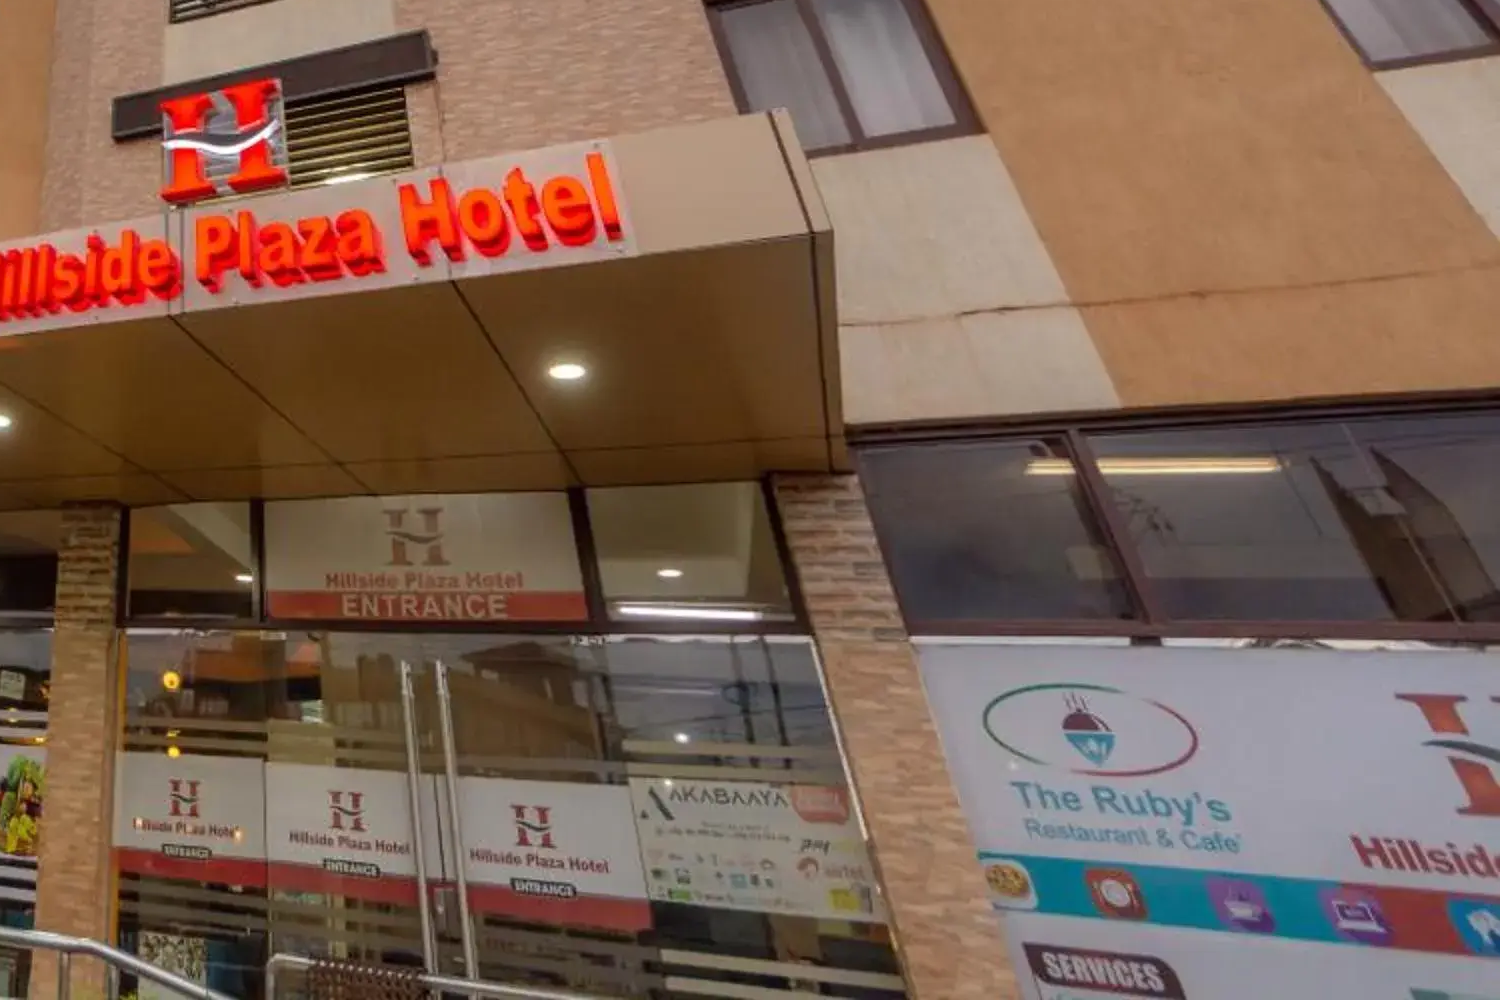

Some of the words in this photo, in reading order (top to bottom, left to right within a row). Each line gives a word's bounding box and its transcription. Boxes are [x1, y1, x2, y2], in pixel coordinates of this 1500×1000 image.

[195, 207, 386, 292] Plaza
[398, 152, 625, 267] Hotel
[325, 571, 399, 589] Hillside
[404, 572, 461, 589] Plaza
[465, 571, 524, 589] Hotel
[341, 594, 508, 619] ENTRANCE
[1010, 781, 1083, 812] The
[1090, 785, 1232, 826] Ruby's
[1022, 817, 1150, 847] Restaurant
[1155, 828, 1175, 849] &
[569, 856, 610, 873] Hotel
[1349, 832, 1500, 878] Hillsid
[1041, 951, 1165, 993] SERVICES
